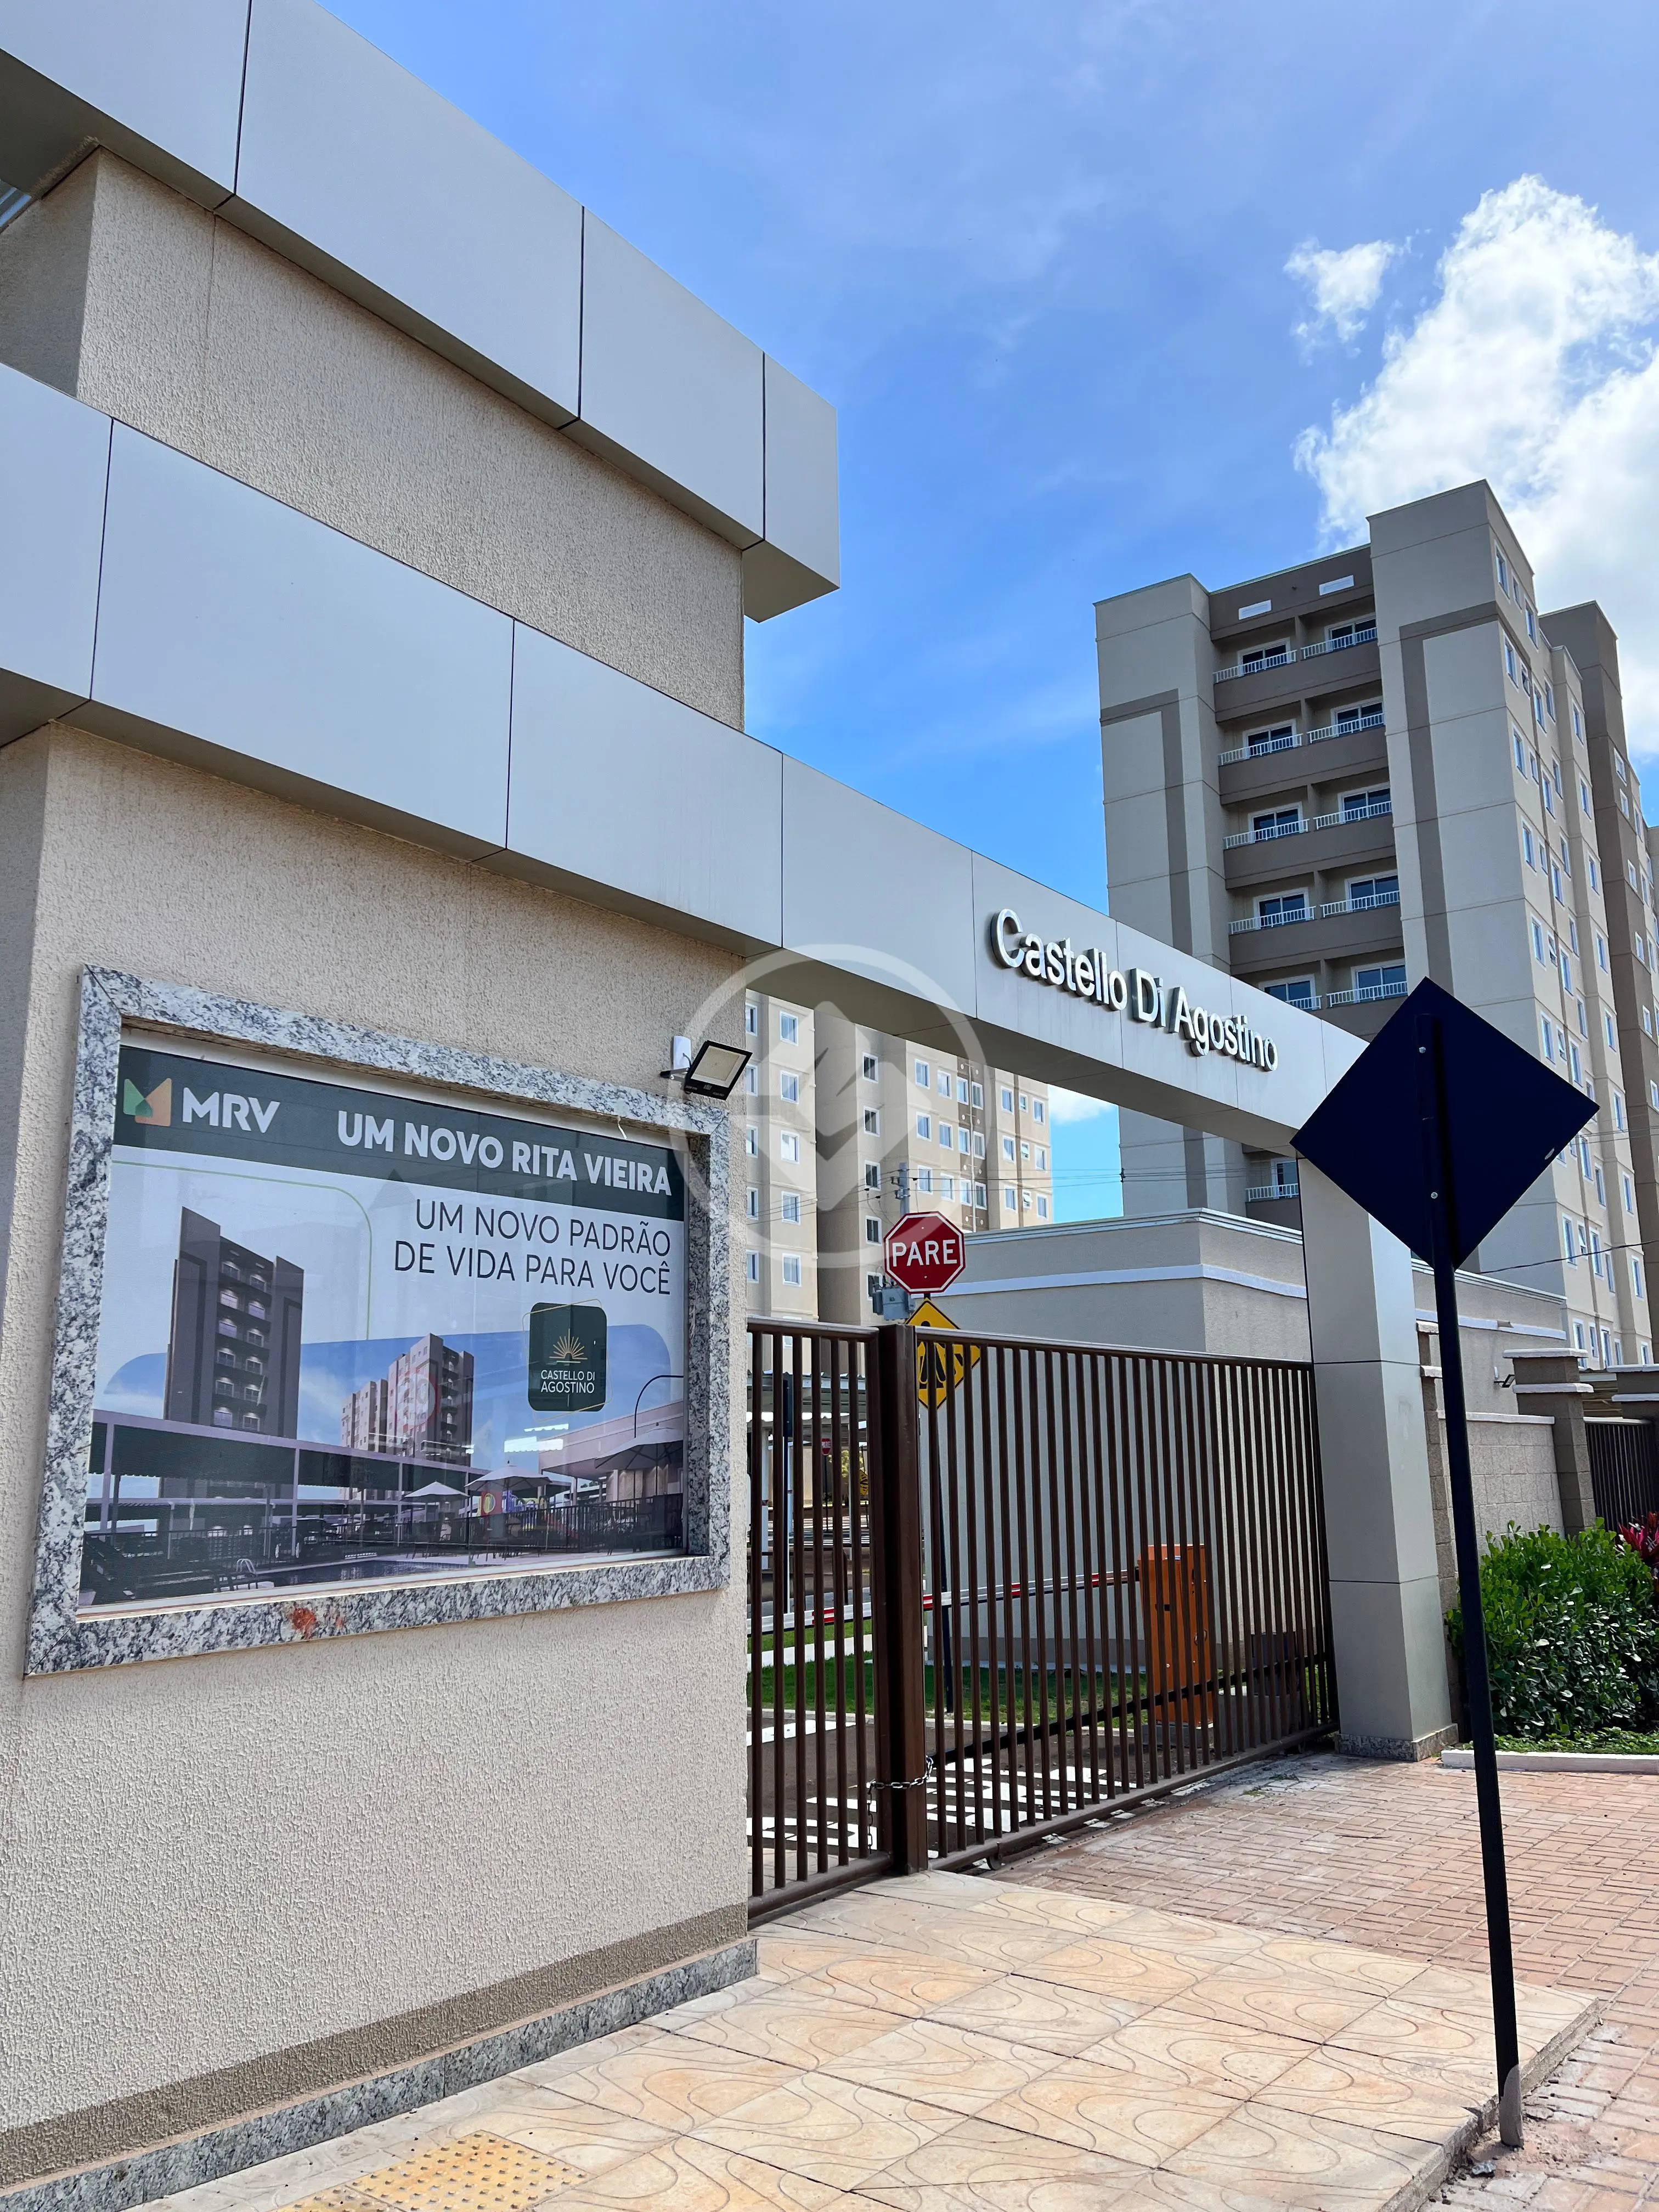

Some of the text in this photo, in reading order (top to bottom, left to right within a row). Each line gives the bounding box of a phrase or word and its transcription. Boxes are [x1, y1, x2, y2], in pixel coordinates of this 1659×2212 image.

[991, 908, 1279, 1072] Castello Di Agostino
[182, 1087, 281, 1134] MRV
[337, 1110, 672, 1196] UM NOVO RITA VIEIRA
[416, 1199, 670, 1257] UM NOVO PADRÃO
[891, 1239, 957, 1267] PARE
[394, 1240, 671, 1295] DE VIDA PARA VOCÊ
[540, 1369, 595, 1381] CASTELLO DI
[540, 1381, 595, 1393] AGOSTINO
